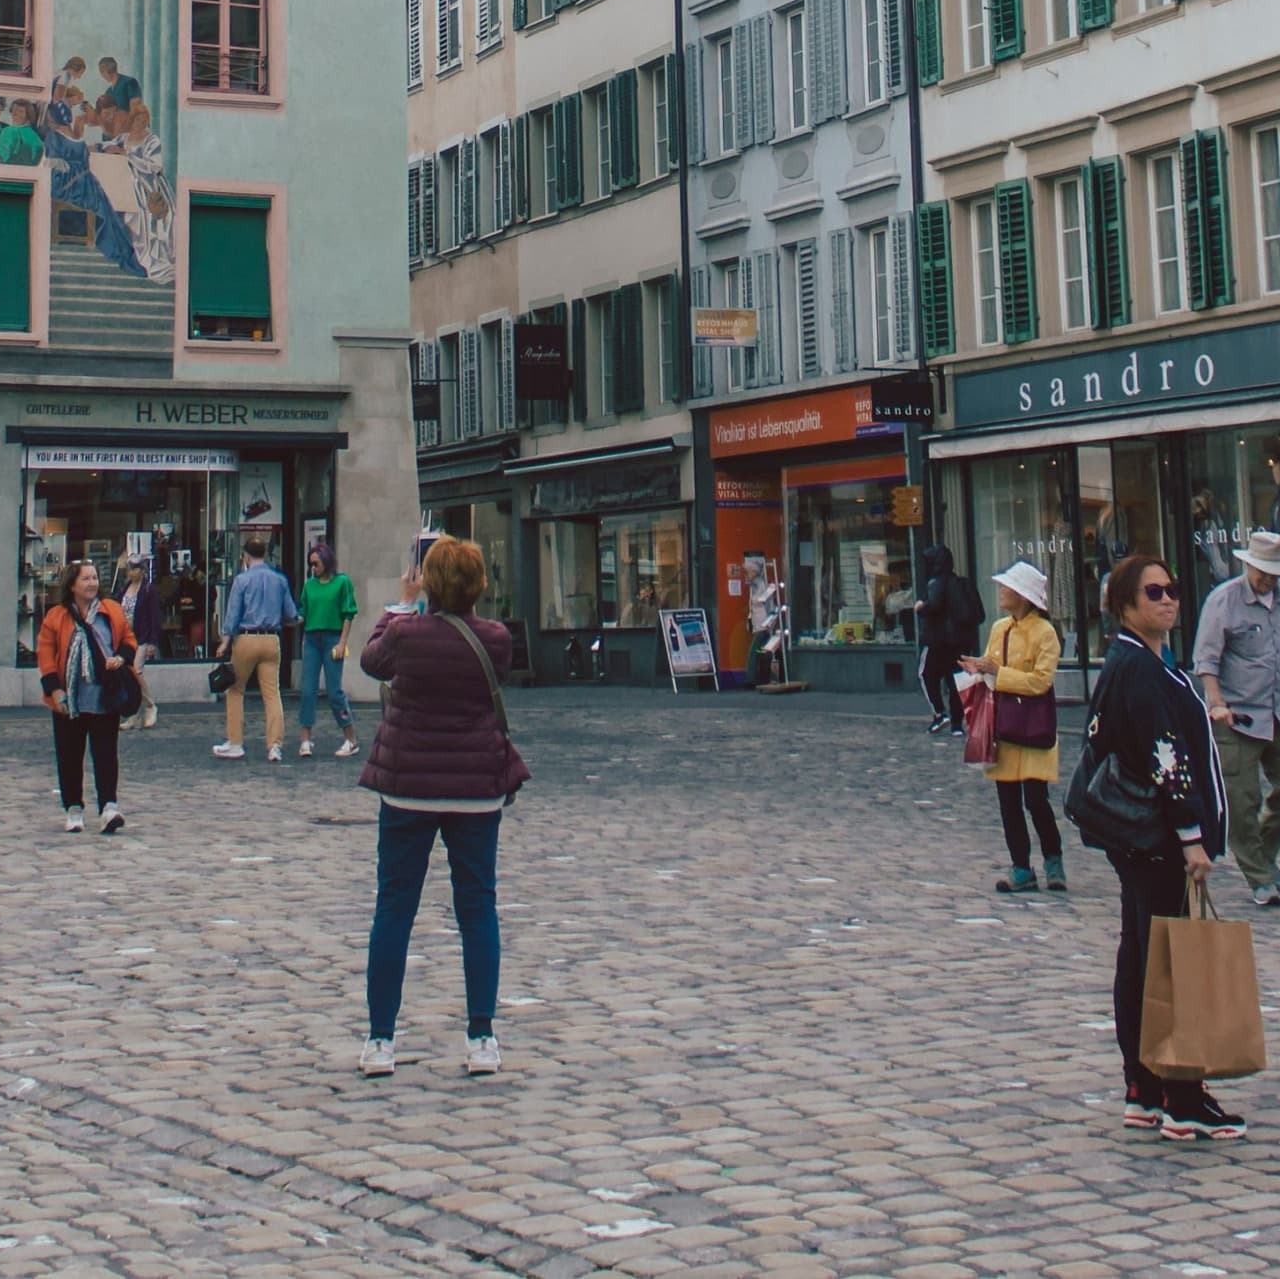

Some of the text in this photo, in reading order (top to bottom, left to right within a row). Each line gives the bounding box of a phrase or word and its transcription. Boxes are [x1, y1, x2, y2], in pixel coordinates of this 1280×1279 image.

[1019, 351, 1215, 412] sandro
[26, 404, 93, 416] COUTELLERIE
[136, 401, 157, 423] H.
[163, 402, 248, 425] WEBER
[875, 403, 932, 416] sandro
[747, 421, 758, 440] ist
[37, 451, 52, 462] YOU
[54, 452, 67, 462] ARE
[70, 452, 78, 462] IN
[81, 452, 93, 463] THE
[96, 452, 118, 463] FIRST
[120, 453, 134, 463] AND
[137, 454, 164, 464] OLDEST
[166, 454, 186, 464] KNIFE
[189, 455, 208, 464] SHOP
